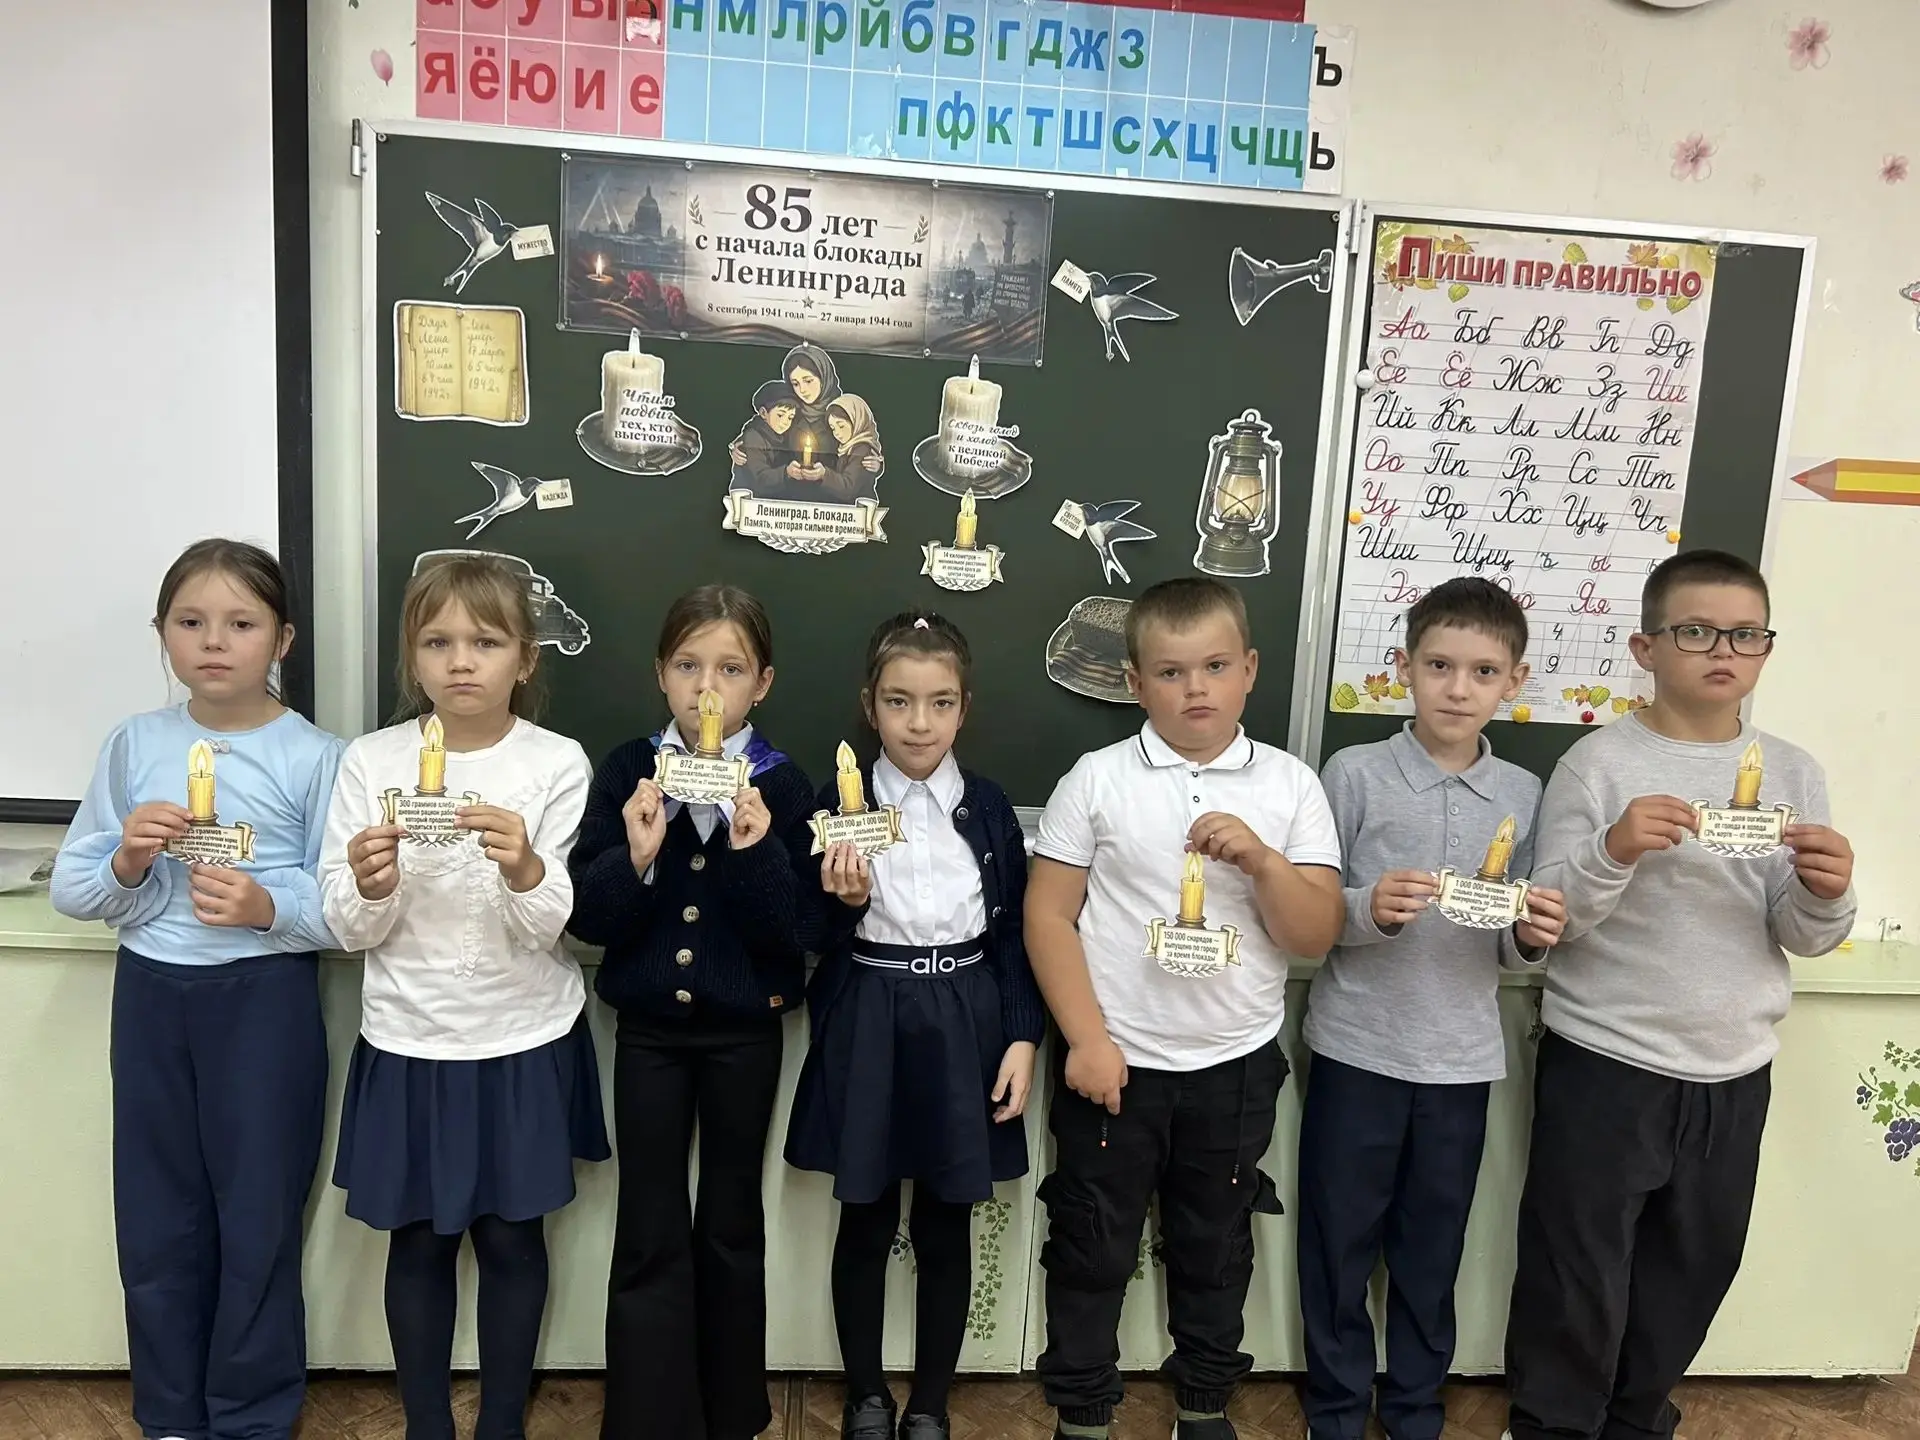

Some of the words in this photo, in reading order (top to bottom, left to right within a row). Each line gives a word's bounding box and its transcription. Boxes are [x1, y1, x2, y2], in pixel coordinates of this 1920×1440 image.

[772, 0, 806, 42] л
[815, 1, 847, 54] р
[860, 0, 890, 48] й
[902, 0, 934, 53] б
[944, 15, 976, 57] в
[997, 20, 1020, 61] г
[1028, 19, 1063, 70] д
[1066, 26, 1108, 71] ж
[424, 52, 457, 94] я
[469, 47, 501, 100] ё
[509, 58, 557, 104] ю
[575, 67, 606, 111] и
[629, 74, 660, 115] е
[898, 97, 928, 136] п
[934, 91, 976, 150] ф
[986, 105, 1013, 145] к
[1026, 106, 1054, 147] т
[1063, 107, 1103, 150] ш
[1186, 123, 1217, 173] ц
[1231, 125, 1258, 165] ч
[1263, 127, 1303, 178] щ
[744, 183, 813, 233] 85
[821, 215, 878, 238] лет
[517, 239, 549, 251] МУЖЕСТВО
[695, 234, 708, 250] с
[716, 235, 806, 258] начала
[813, 238, 923, 270] блокады
[711, 257, 907, 300] Ленинграда
[1061, 275, 1083, 295] ПАМЯТЬ
[707, 303, 714, 312] 8
[715, 304, 758, 317] сентября
[760, 307, 782, 317] 1941
[784, 310, 805, 320] года
[820, 312, 831, 321] 27
[834, 314, 866, 325] января
[869, 315, 890, 326] 1944
[893, 319, 913, 329] года
[1454, 310, 1503, 344] Бб
[1522, 316, 1567, 351] Вв
[1645, 323, 1694, 369] Дд
[1493, 357, 1563, 393] Жж
[1588, 365, 1627, 413] Зз
[623, 388, 674, 406] Чтим
[621, 404, 674, 420] подвиг
[1373, 390, 1416, 430] Йй
[1430, 394, 1476, 434] Кк
[1637, 410, 1682, 446] Нн
[620, 420, 646, 432] тех,
[649, 423, 673, 433] кто
[948, 419, 985, 434] Сквозь
[989, 425, 1018, 436] голод
[614, 430, 678, 444] выстоял!
[966, 435, 998, 445] холод
[948, 444, 956, 452] к
[958, 447, 1007, 459] великой
[954, 454, 999, 469] Победе!
[542, 491, 568, 502] НАДЕЖДА
[756, 504, 811, 521] Ленинград.
[813, 508, 856, 523] Блокада.
[1421, 485, 1469, 531] Фф
[744, 517, 773, 530] Память,
[774, 522, 802, 532] которая
[804, 523, 834, 533] сильнее
[835, 525, 865, 535] времени
[1552, 623, 1564, 641] 4
[1604, 626, 1617, 644] 5
[1545, 654, 1560, 674] 9
[679, 759, 693, 768] 872
[833, 820, 844, 829] 800
[867, 816, 877, 825] 000
[877, 815, 887, 823] 000
[1708, 812, 1723, 821] 97%
[1459, 880, 1472, 889] 000
[1472, 882, 1485, 891] 000
[1164, 931, 1174, 940] 150
[1175, 932, 1186, 941] 000
[910, 948, 957, 974] alo
